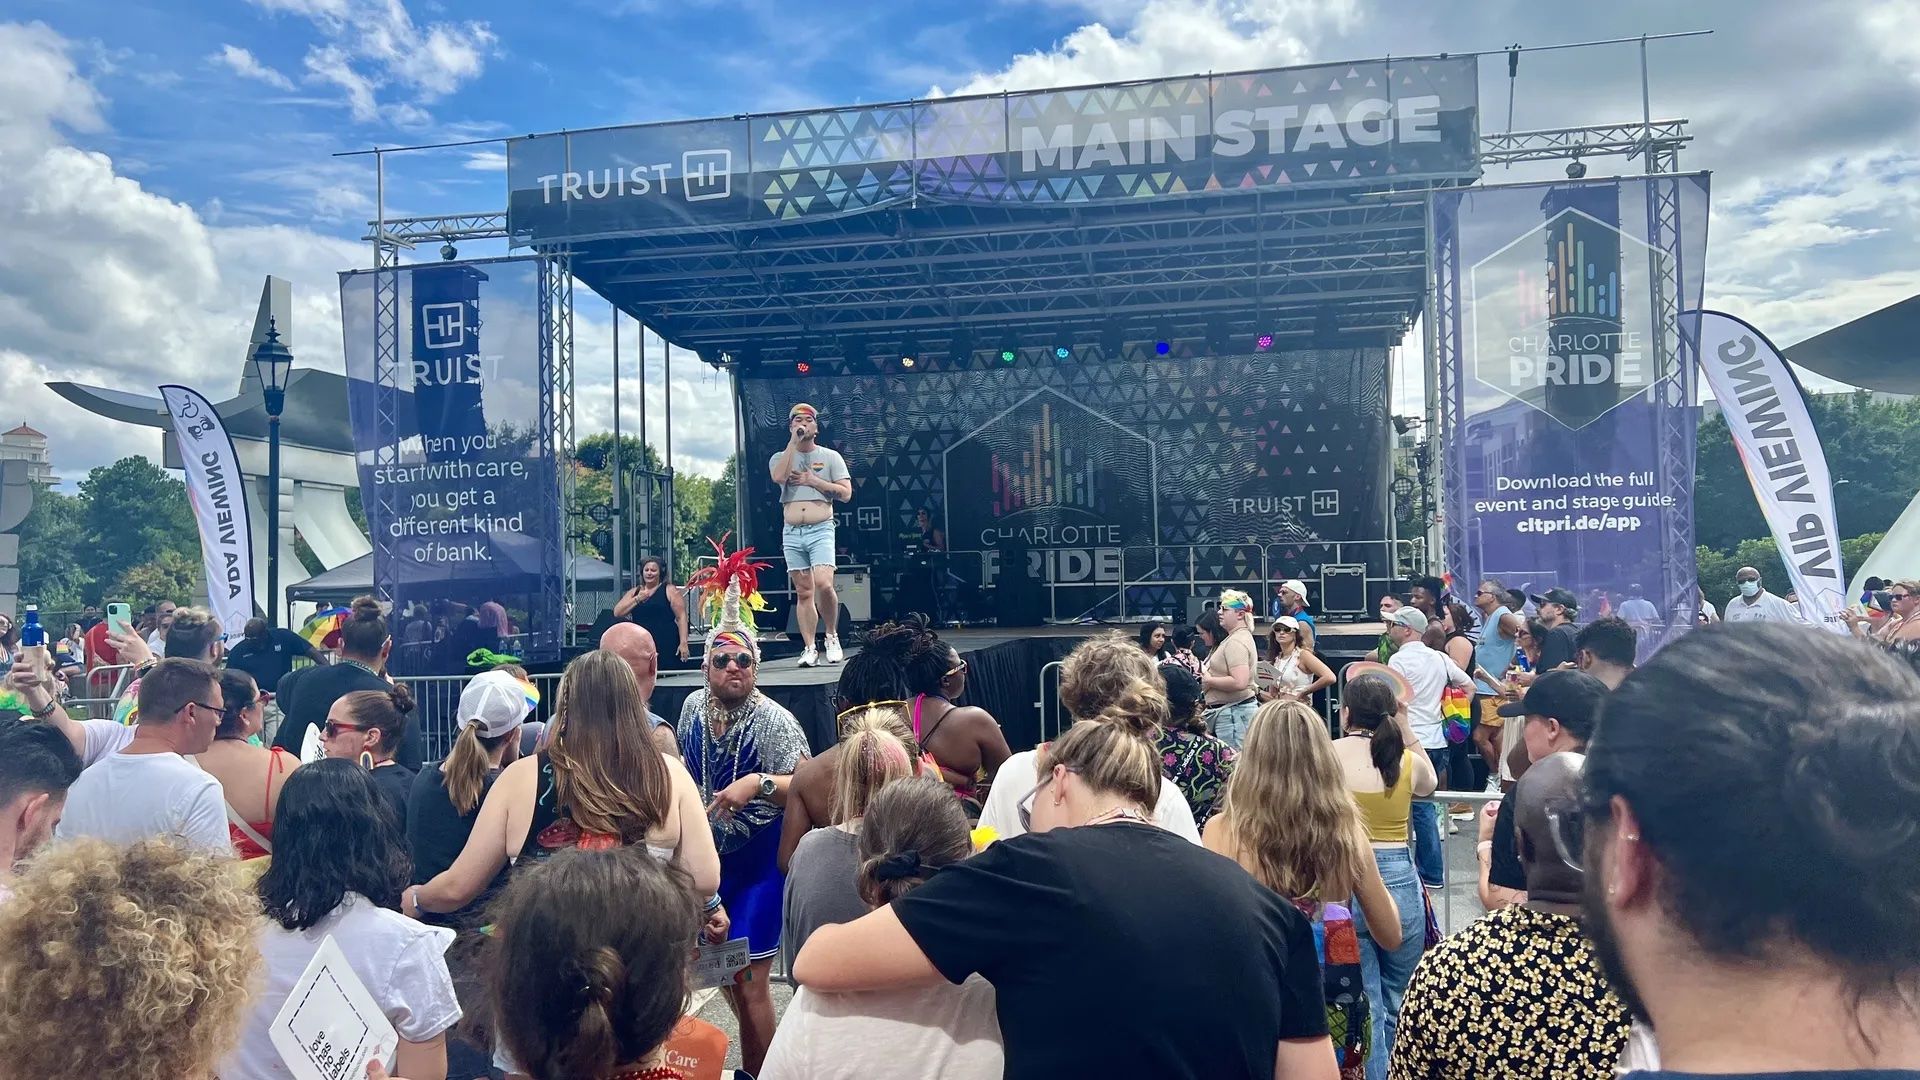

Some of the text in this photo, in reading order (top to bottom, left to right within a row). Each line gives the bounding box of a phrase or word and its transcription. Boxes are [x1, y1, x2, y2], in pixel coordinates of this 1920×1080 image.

[1022, 95, 1442, 173] MAIN STAGE
[537, 162, 672, 204] TRUIST
[1508, 331, 1642, 353] CHARLOTTE
[385, 353, 504, 387] TRUIST
[1509, 352, 1642, 386] PRIDE
[398, 433, 497, 456] When you
[475, 460, 529, 481] care,
[1496, 471, 1654, 491] Download the full
[409, 487, 497, 513] you get a
[1228, 495, 1306, 514] TRUIST
[1474, 492, 1676, 513] event and stage guide:
[474, 511, 523, 534] kind
[1516, 513, 1641, 535] cltpri.de/app
[980, 524, 1122, 546] CHARLOTTE
[414, 541, 493, 563] of bank.
[309, 1030, 325, 1055] love
[315, 1042, 331, 1064] has
[323, 1055, 334, 1072] no
[328, 1047, 350, 1080] labels
[666, 1049, 698, 1068] Care
